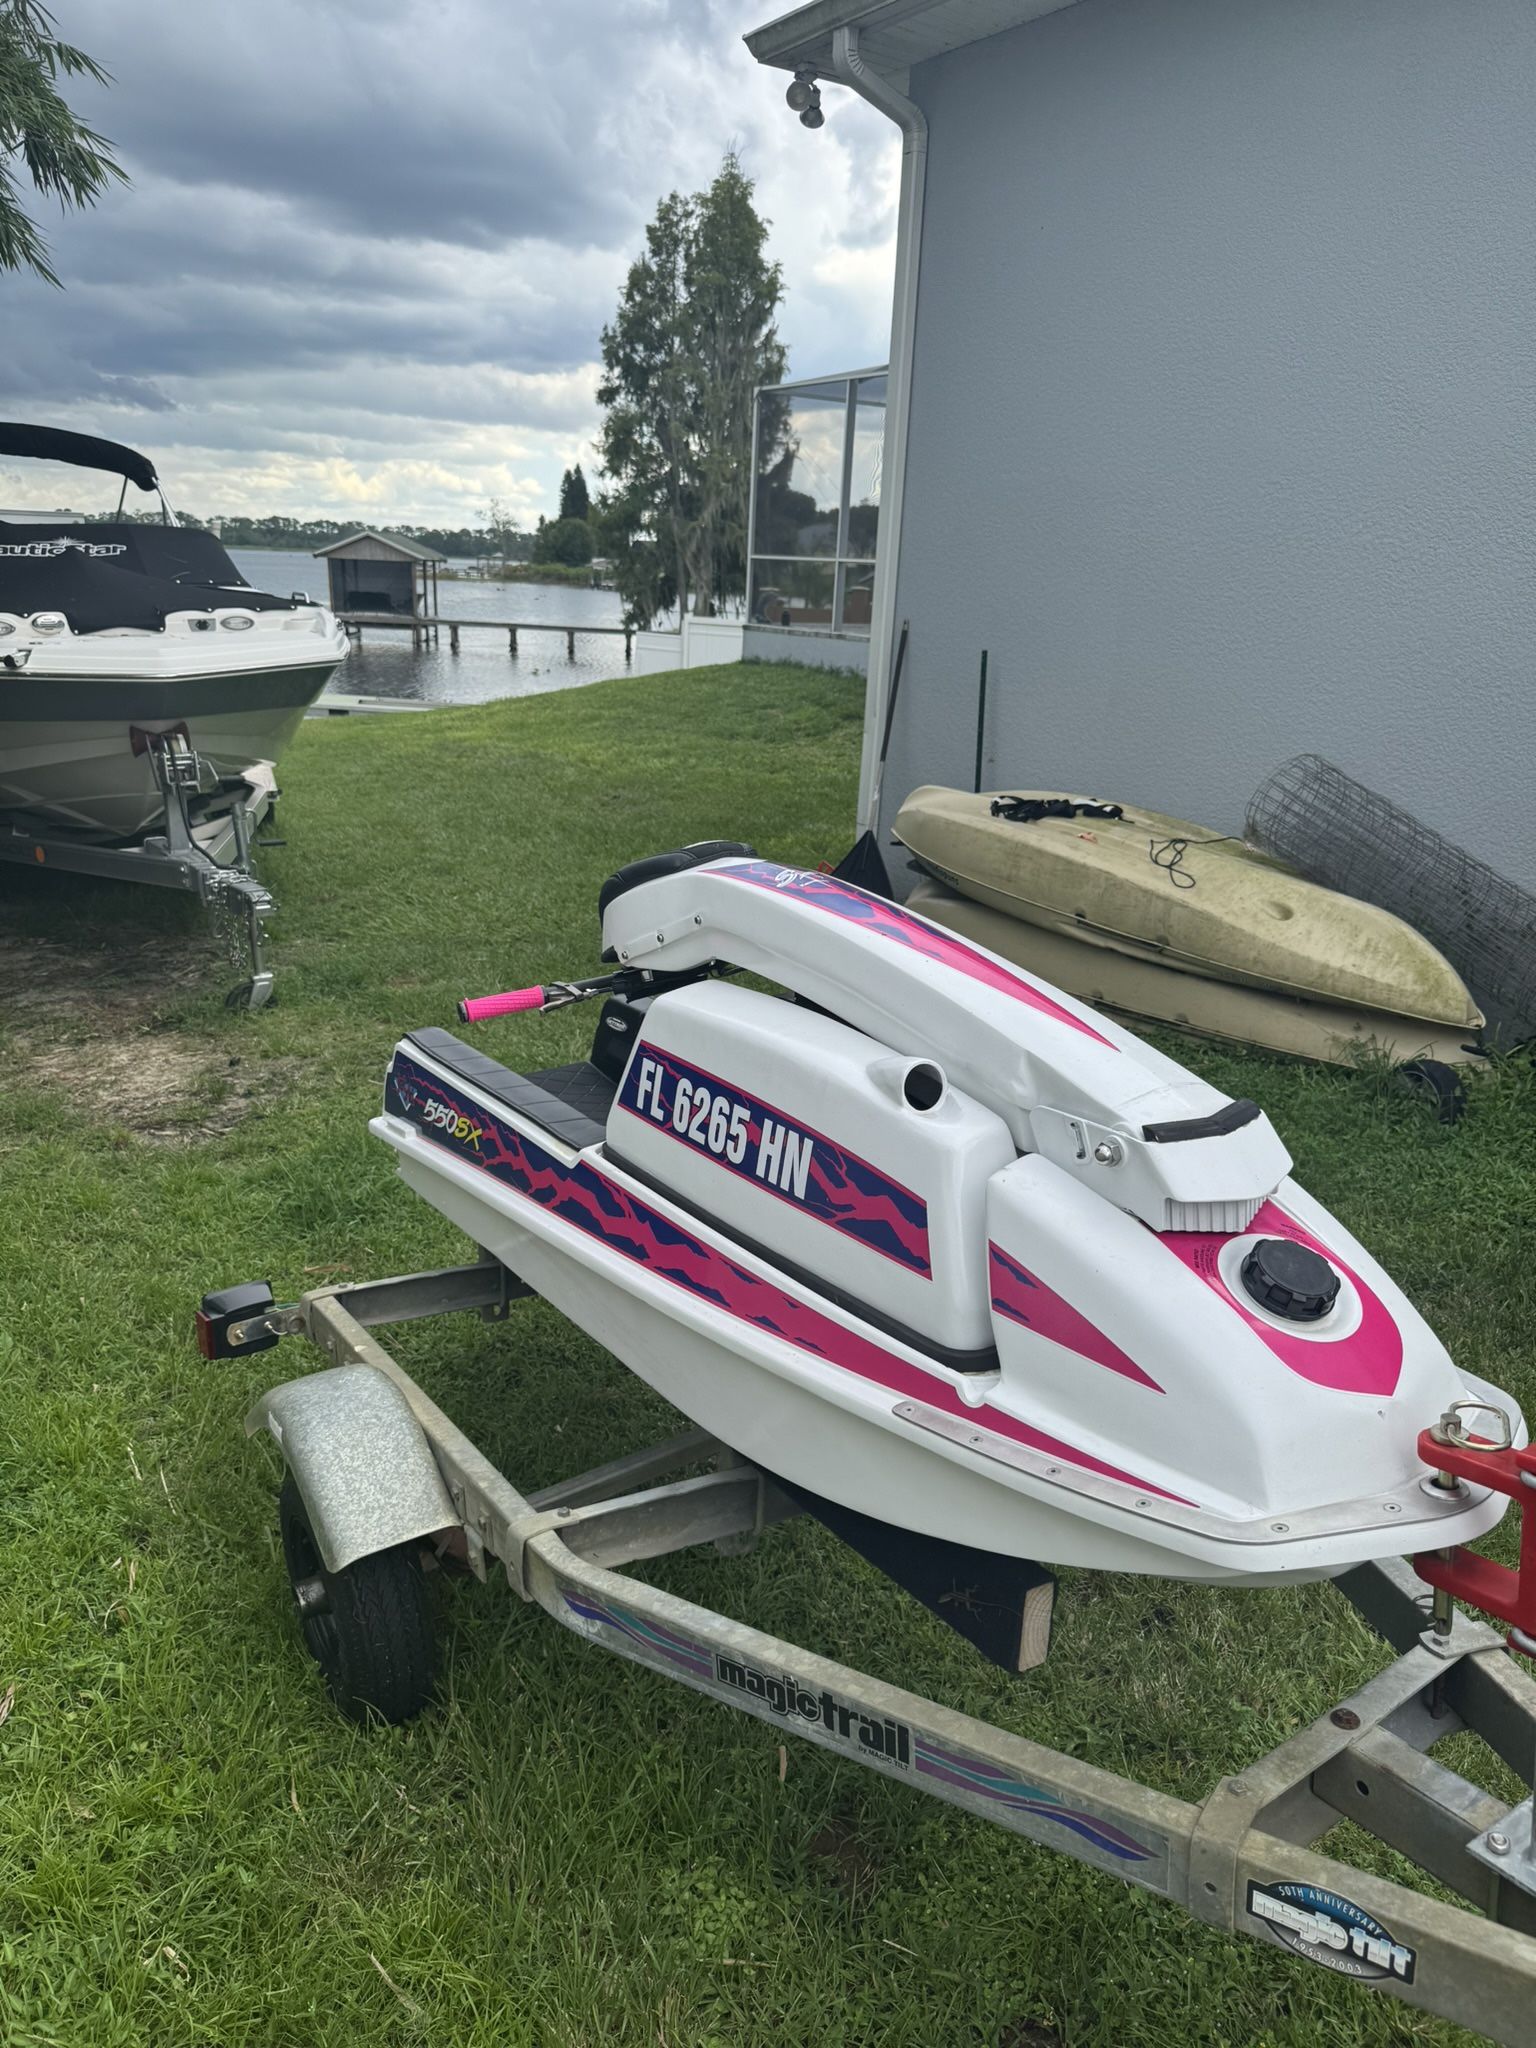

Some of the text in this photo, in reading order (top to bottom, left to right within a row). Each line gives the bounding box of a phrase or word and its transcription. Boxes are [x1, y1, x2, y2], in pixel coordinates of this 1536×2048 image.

[423, 1098, 482, 1151] 550SX
[636, 1058, 814, 1200] FL 6265 HN
[1252, 1890, 1412, 1977] magic tilt
[1278, 1885, 1383, 1936] 50TH ANNIVERSARY
